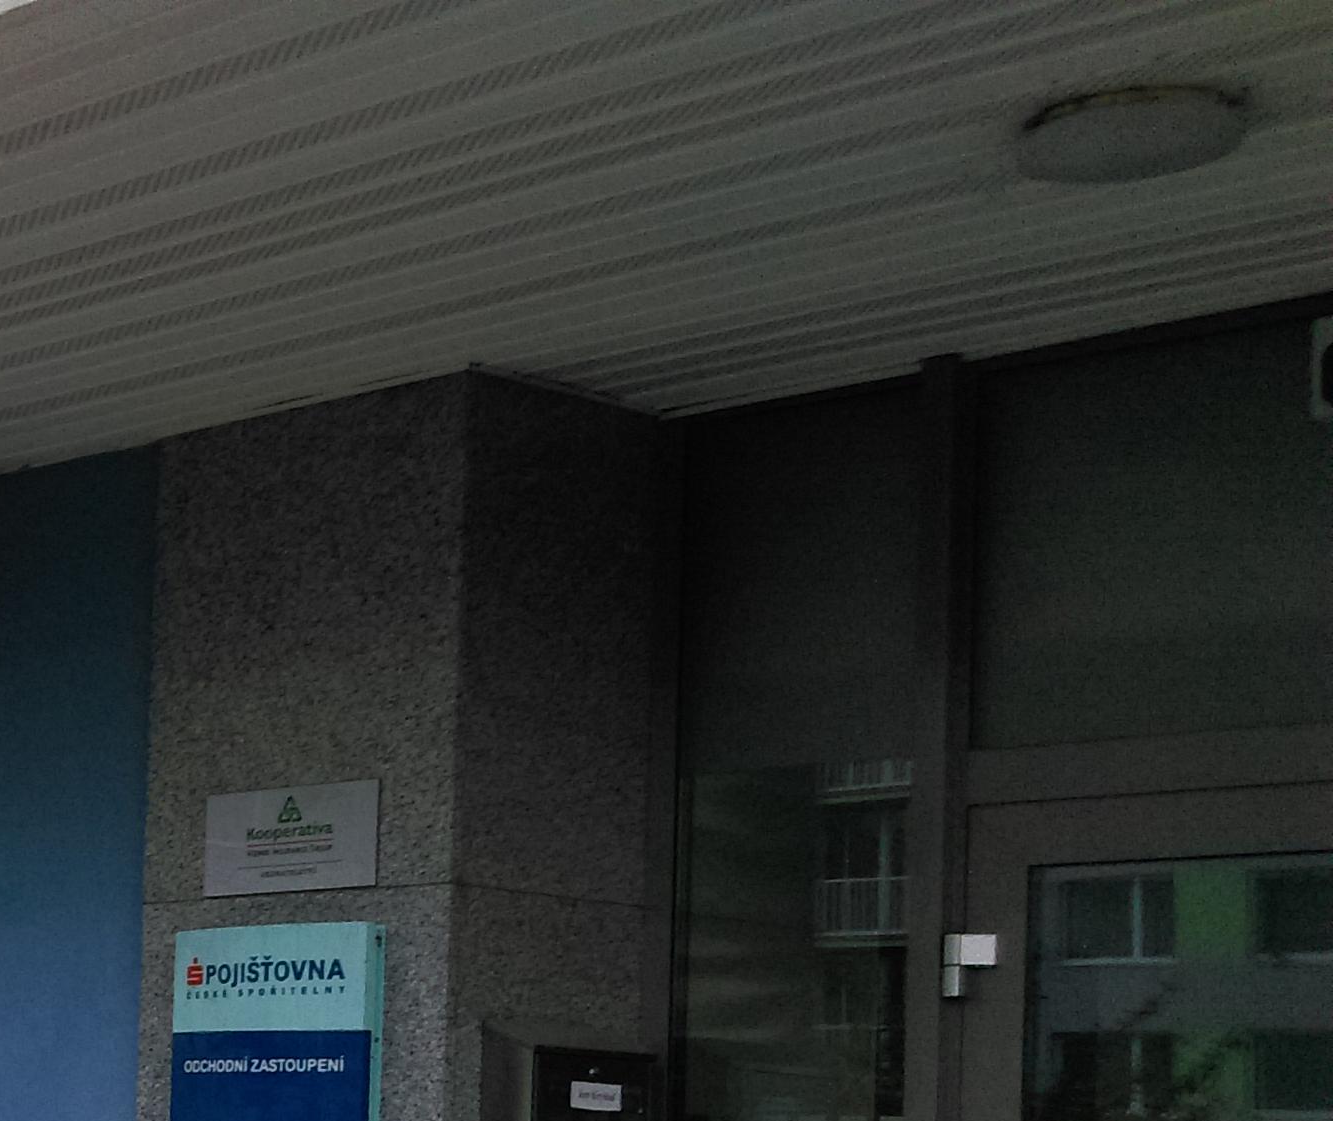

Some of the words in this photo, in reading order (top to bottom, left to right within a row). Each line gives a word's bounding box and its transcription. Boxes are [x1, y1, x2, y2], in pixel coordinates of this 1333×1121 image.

[246, 823, 334, 842] Kooperativa
[205, 955, 346, 988] POJIŠŤOVNA
[250, 1055, 346, 1073] ZASTOUPENÍ
